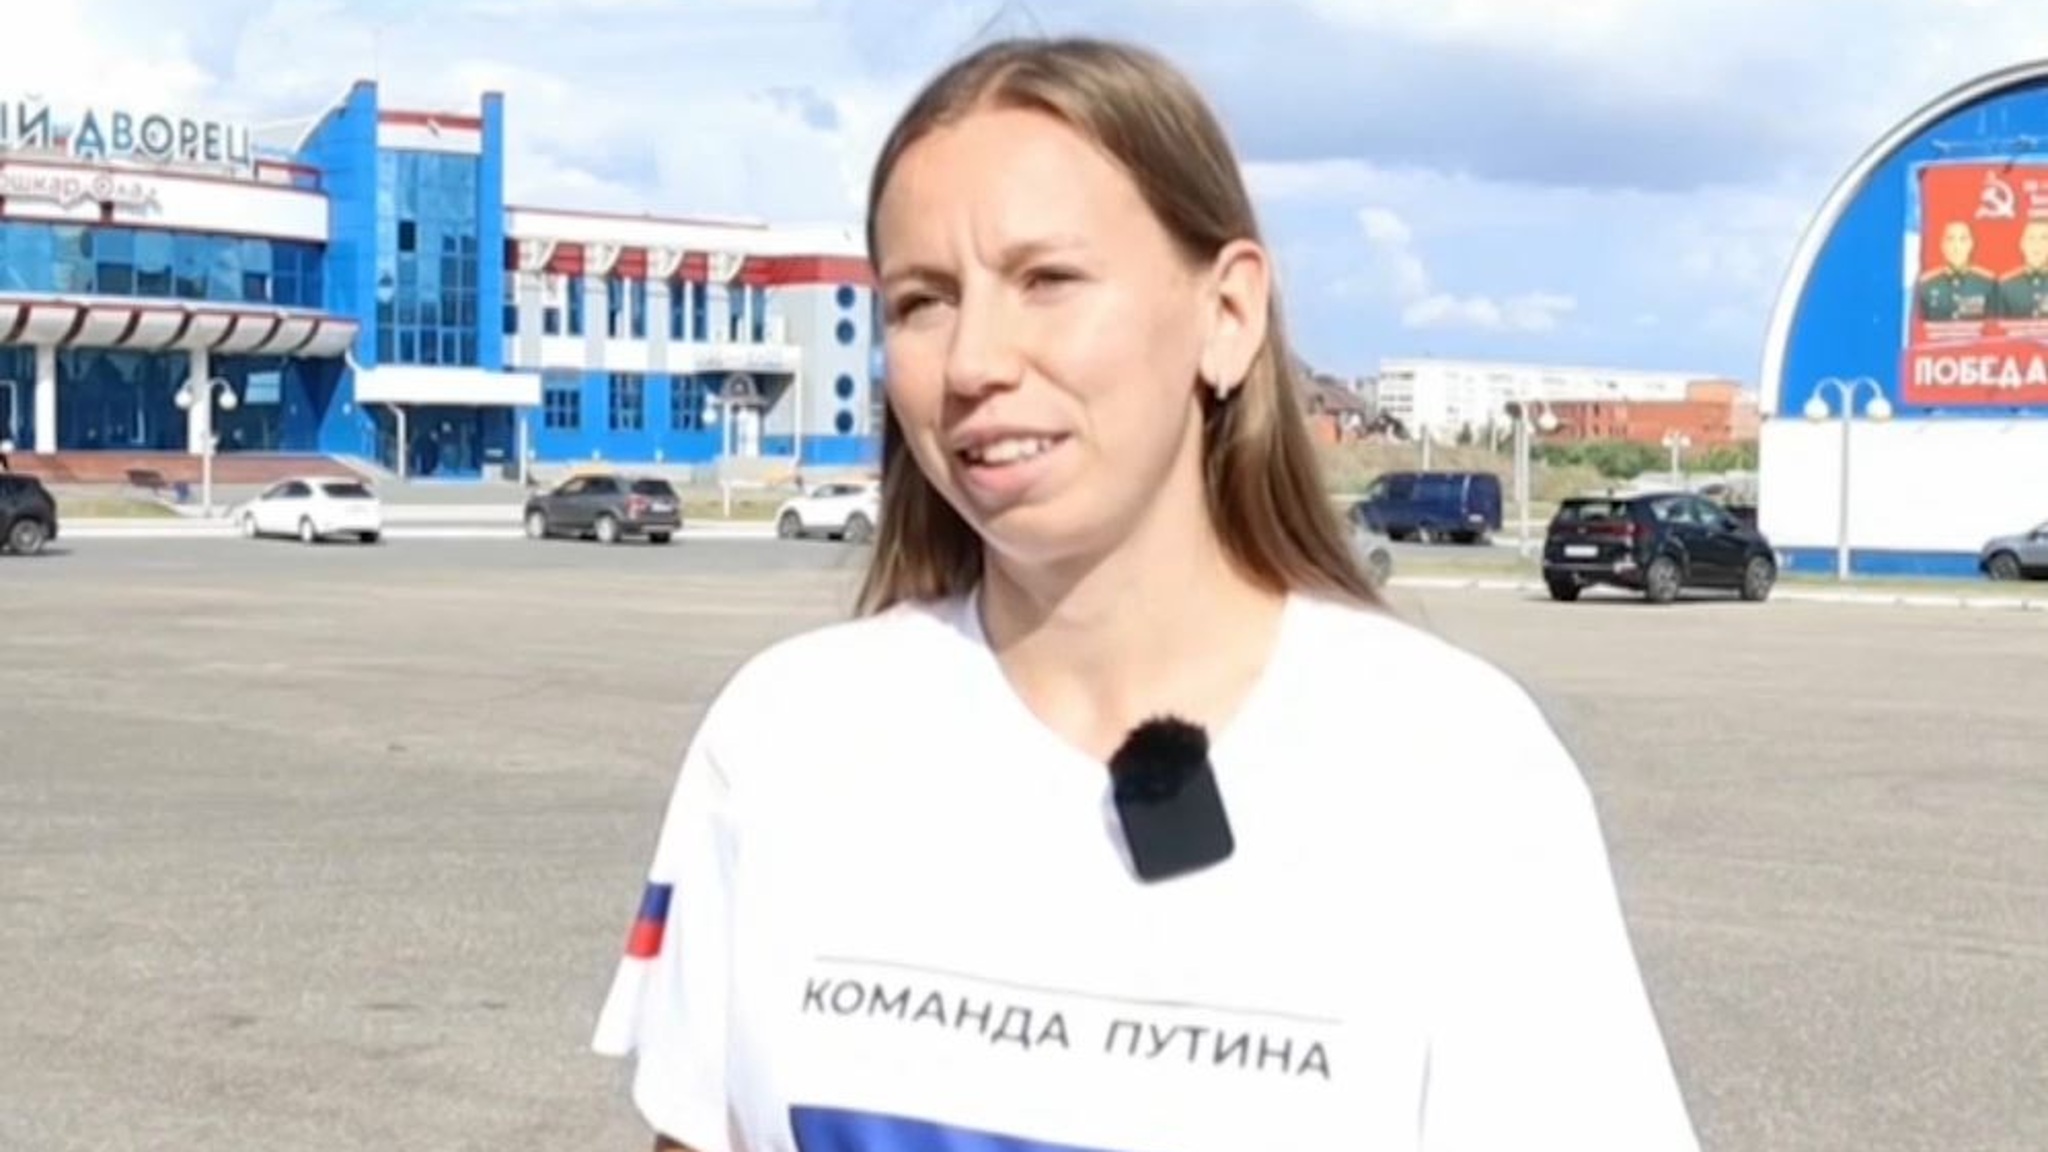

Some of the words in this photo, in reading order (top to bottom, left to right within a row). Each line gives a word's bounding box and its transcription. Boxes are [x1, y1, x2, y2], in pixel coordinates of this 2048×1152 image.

[0, 94, 49, 150] Й
[75, 108, 249, 166] ДВОРЕЦ
[1914, 355, 2048, 389] ПОБЕДА
[802, 976, 1071, 1052] КОМАНДА
[1104, 1017, 1332, 1081] ПУТИНА
